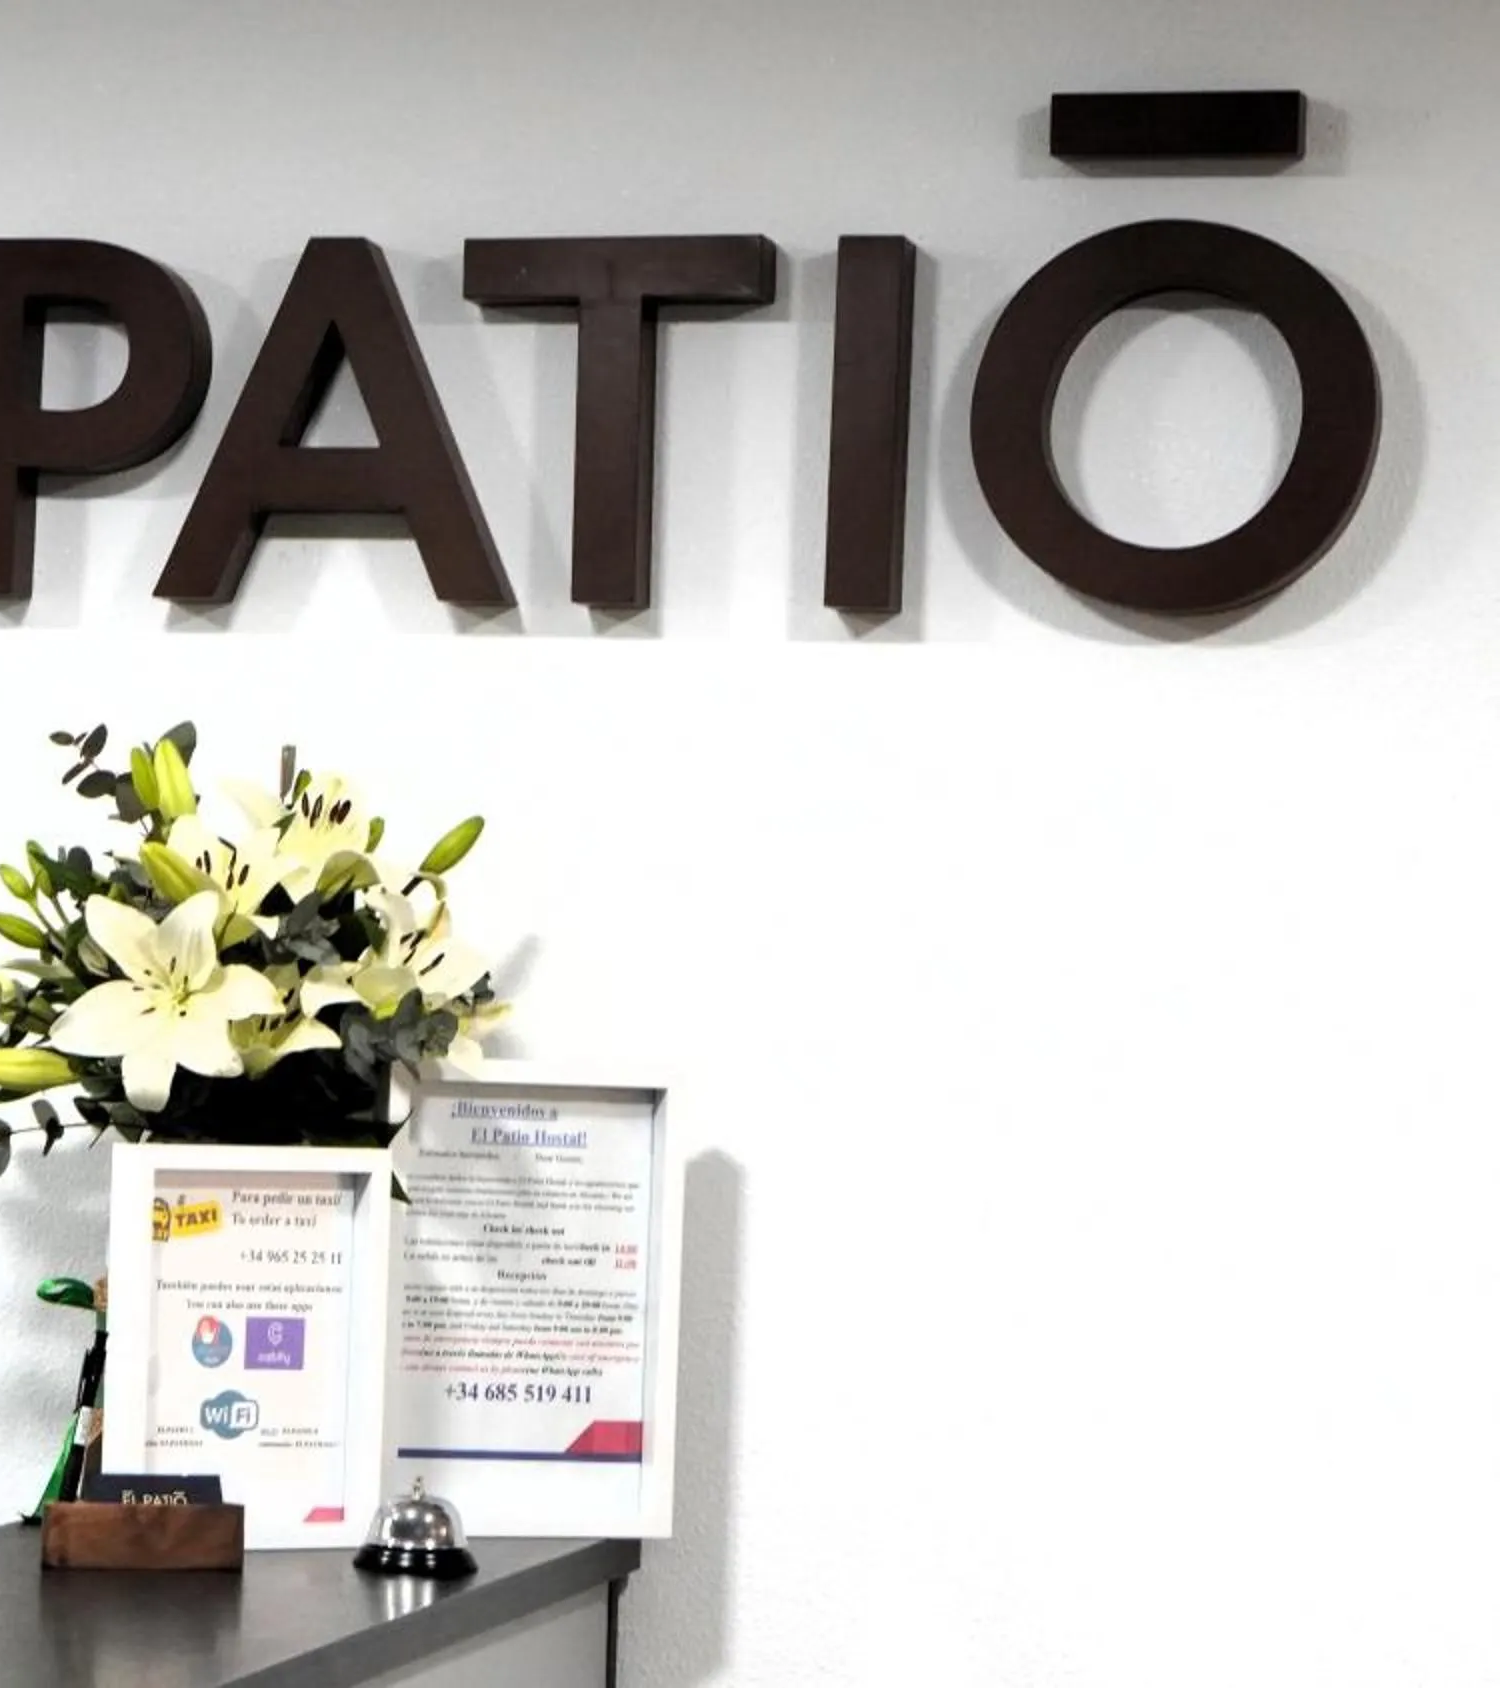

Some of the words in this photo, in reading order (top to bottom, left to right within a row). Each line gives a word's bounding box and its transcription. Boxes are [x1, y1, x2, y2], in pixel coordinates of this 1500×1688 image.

[470, 1127, 488, 1146] El
[492, 1127, 530, 1147] Patio
[232, 1190, 260, 1204] Para
[263, 1190, 293, 1208] pedir
[297, 1194, 313, 1205] un
[174, 1207, 218, 1229] TAXI
[232, 1212, 246, 1225] To
[249, 1213, 281, 1226] order
[284, 1217, 291, 1226] a
[240, 1249, 263, 1262] +34
[267, 1250, 289, 1263] 965
[293, 1250, 307, 1264] 25
[311, 1251, 326, 1264] 25
[331, 1251, 342, 1264] 11
[445, 1382, 478, 1402] +34
[485, 1382, 517, 1402] 685
[523, 1384, 557, 1402] 519
[562, 1385, 591, 1403] 411
